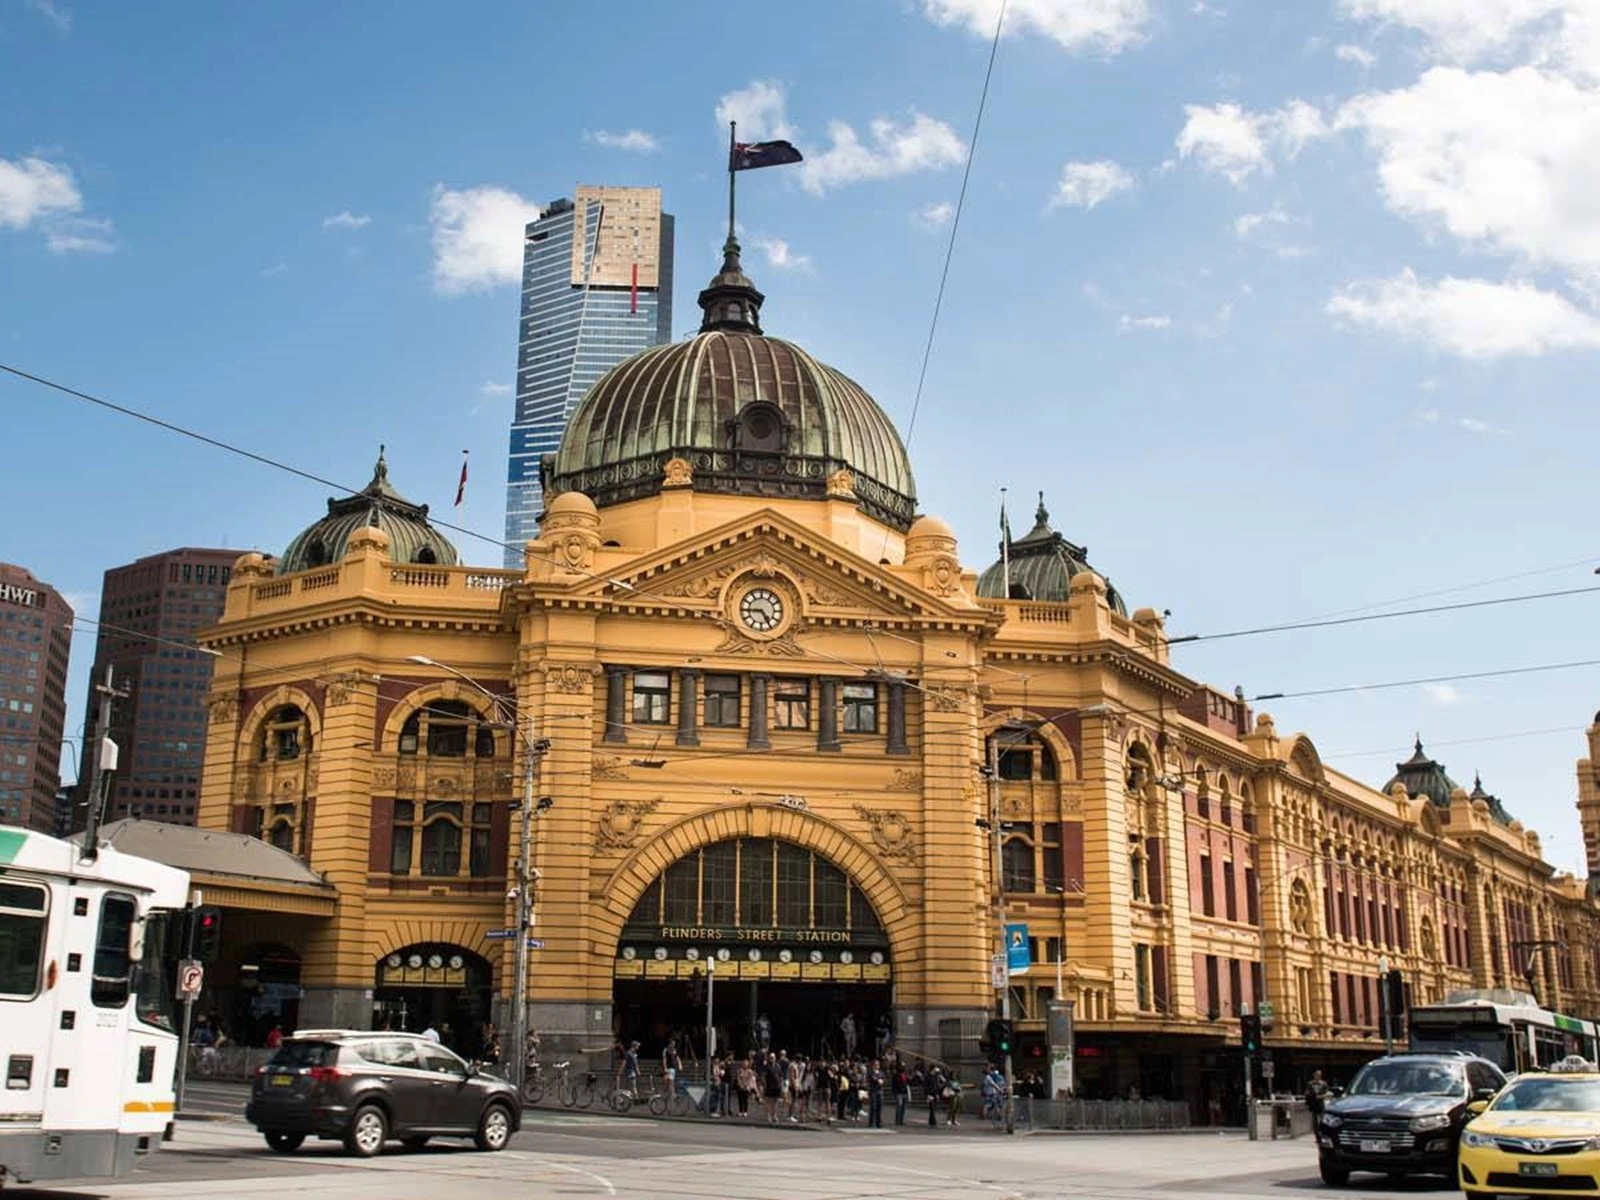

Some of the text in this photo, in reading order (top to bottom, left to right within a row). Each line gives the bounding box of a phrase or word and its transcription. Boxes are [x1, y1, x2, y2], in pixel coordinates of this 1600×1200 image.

[0, 583, 36, 605] HWT
[661, 928, 851, 942] FLINDERS STREET STATION
